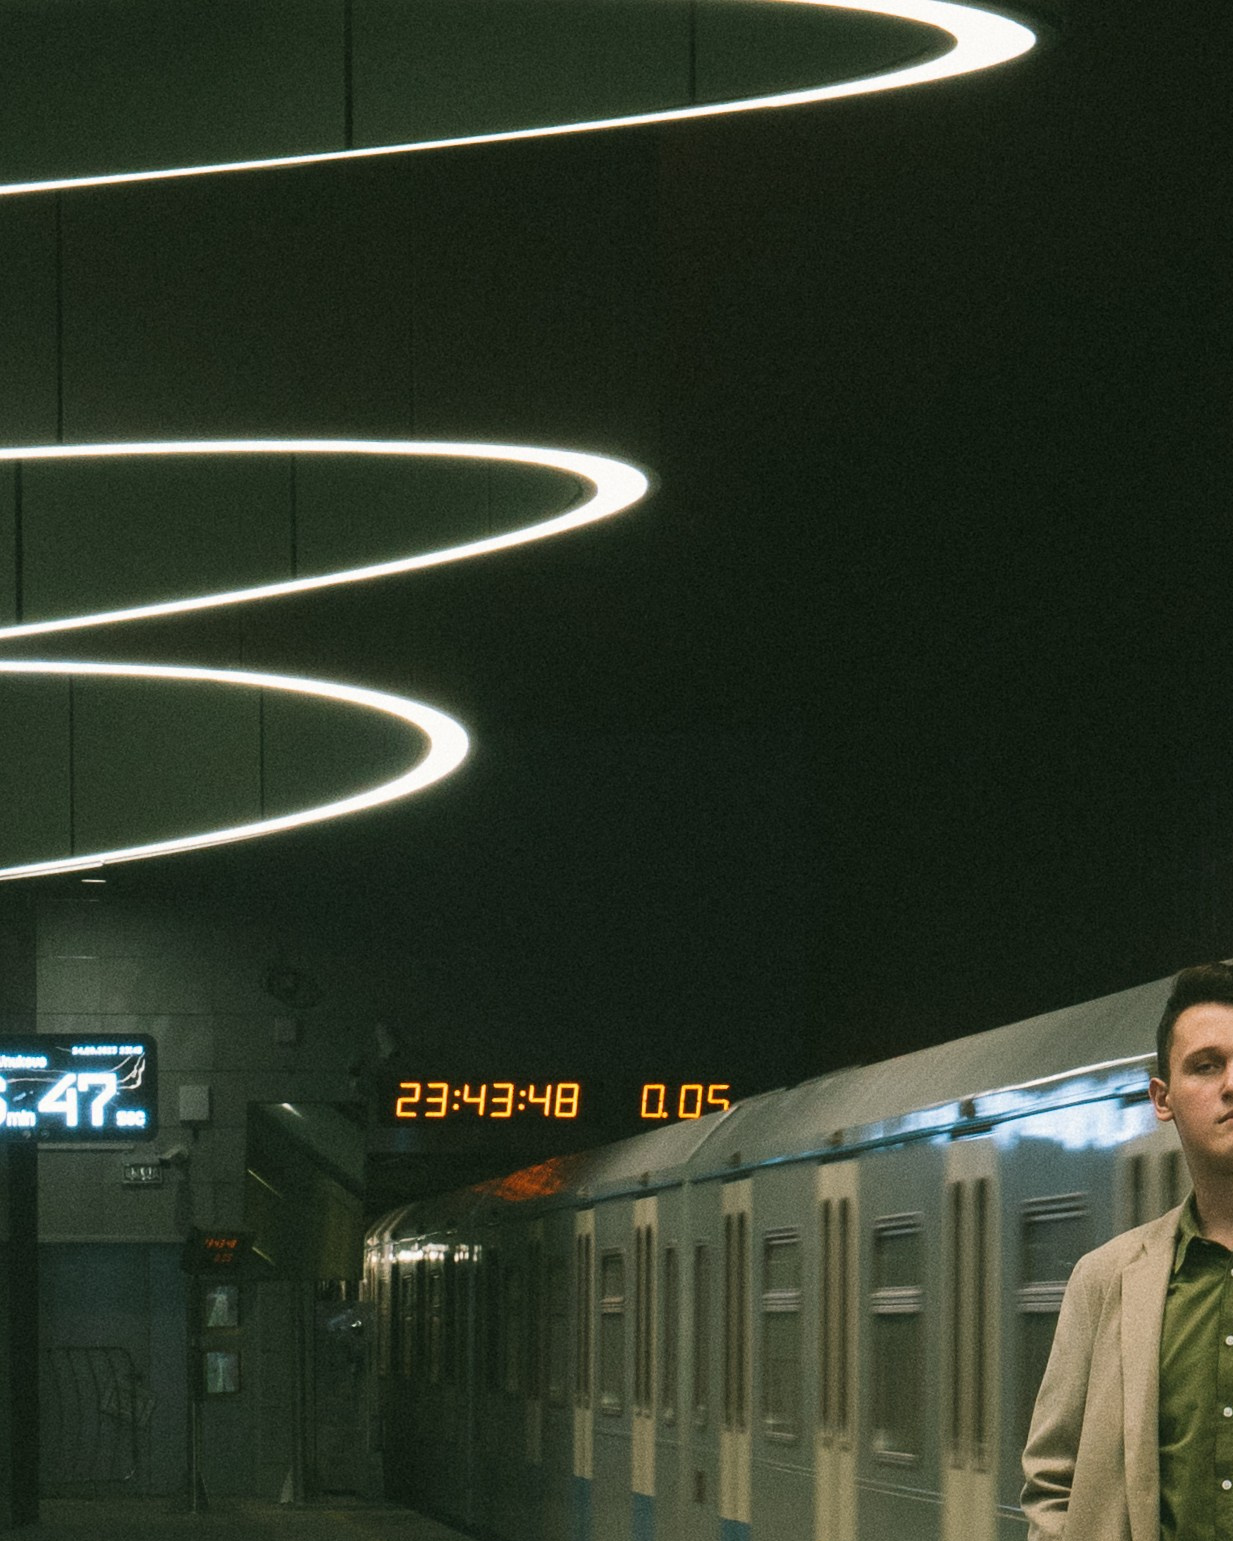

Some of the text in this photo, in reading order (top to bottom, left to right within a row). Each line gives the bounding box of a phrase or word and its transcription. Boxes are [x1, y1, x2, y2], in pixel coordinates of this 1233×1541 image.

[6, 1072, 147, 1127] min 47 sec
[395, 1082, 580, 1118] 23:43:48
[640, 1083, 730, 1119] 0.05
